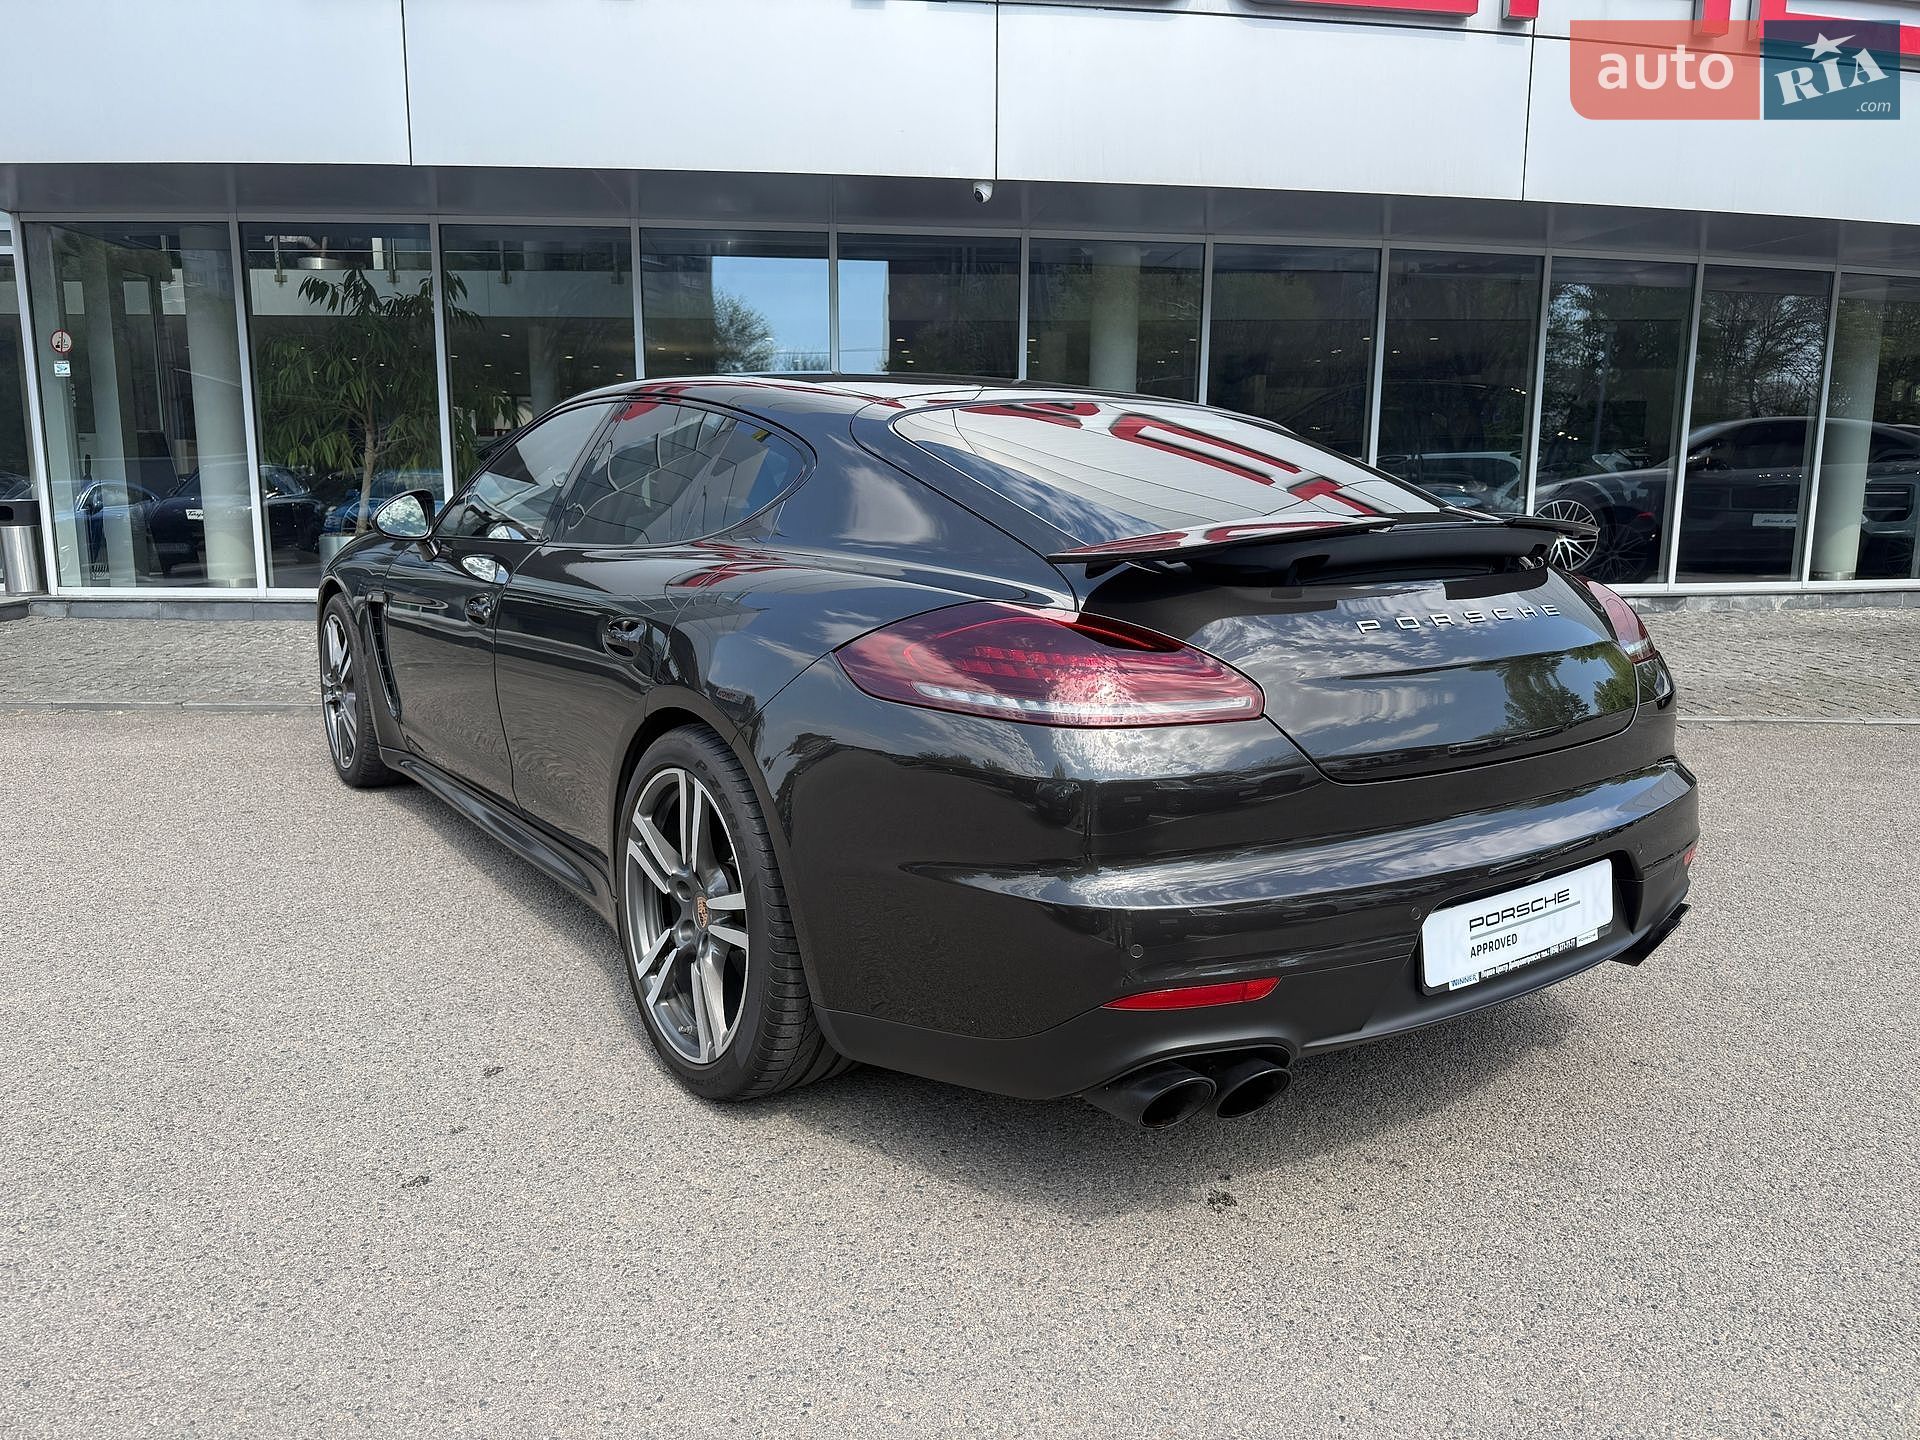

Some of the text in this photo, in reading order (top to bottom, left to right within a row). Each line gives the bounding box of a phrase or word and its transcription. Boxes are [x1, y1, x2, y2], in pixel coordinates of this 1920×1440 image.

[1355, 604, 1560, 634] PORSCHE
[1469, 888, 1570, 932] PORSCHE
[1470, 933, 1518, 958] APPROVED
